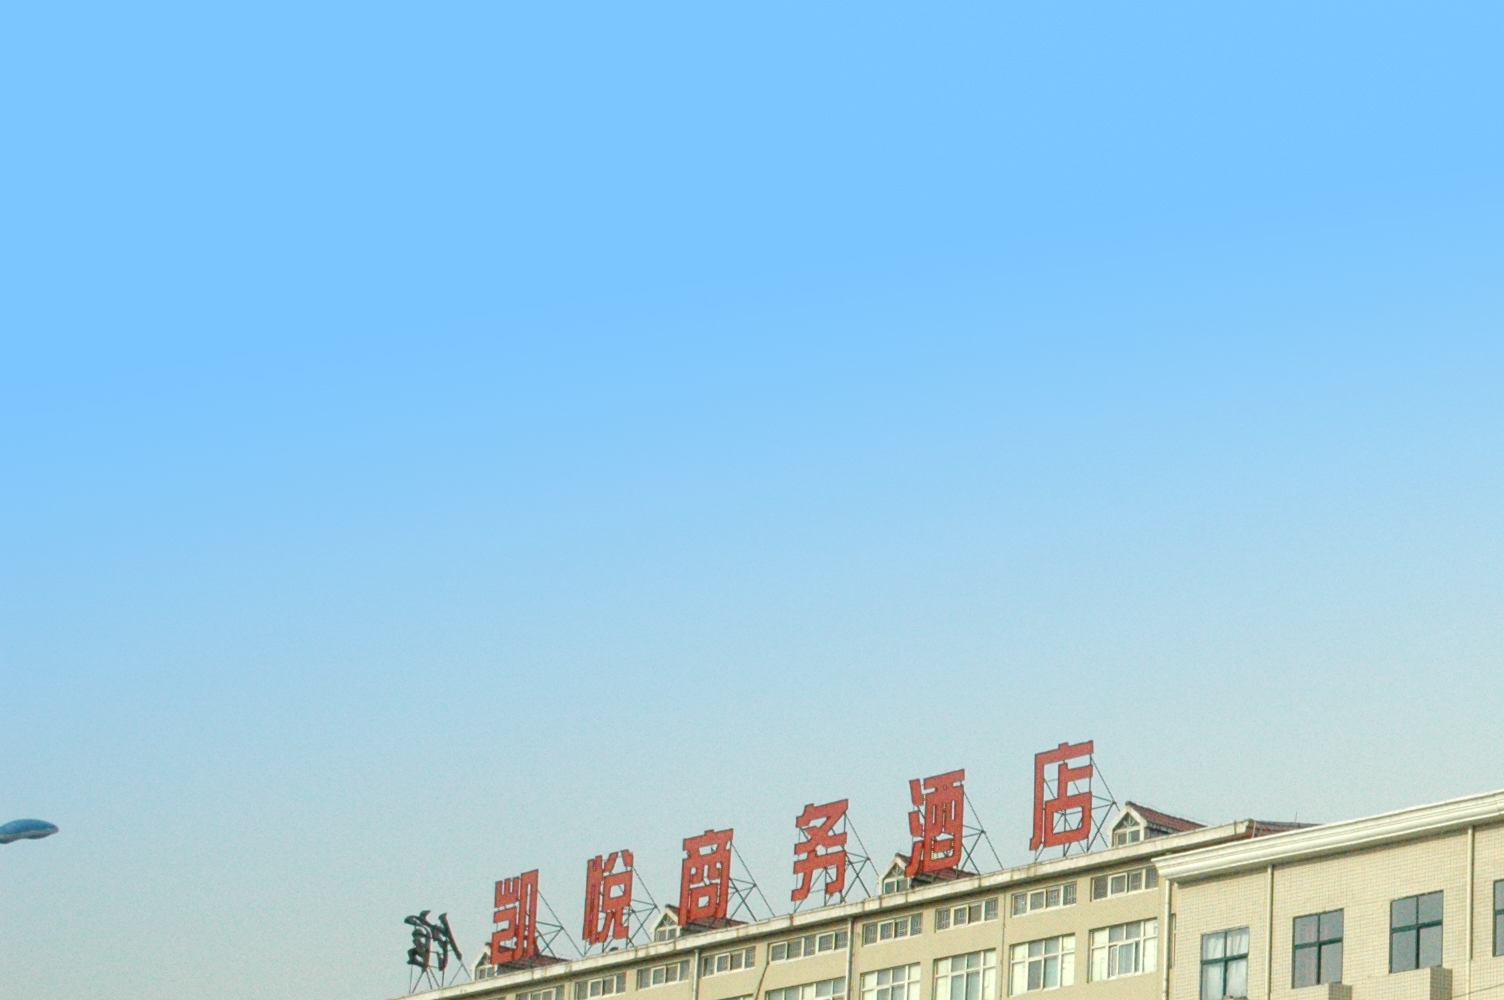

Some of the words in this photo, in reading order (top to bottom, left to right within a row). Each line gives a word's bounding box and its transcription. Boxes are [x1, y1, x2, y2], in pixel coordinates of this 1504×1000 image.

[490, 740, 1094, 966] 凯悦商务酒店
